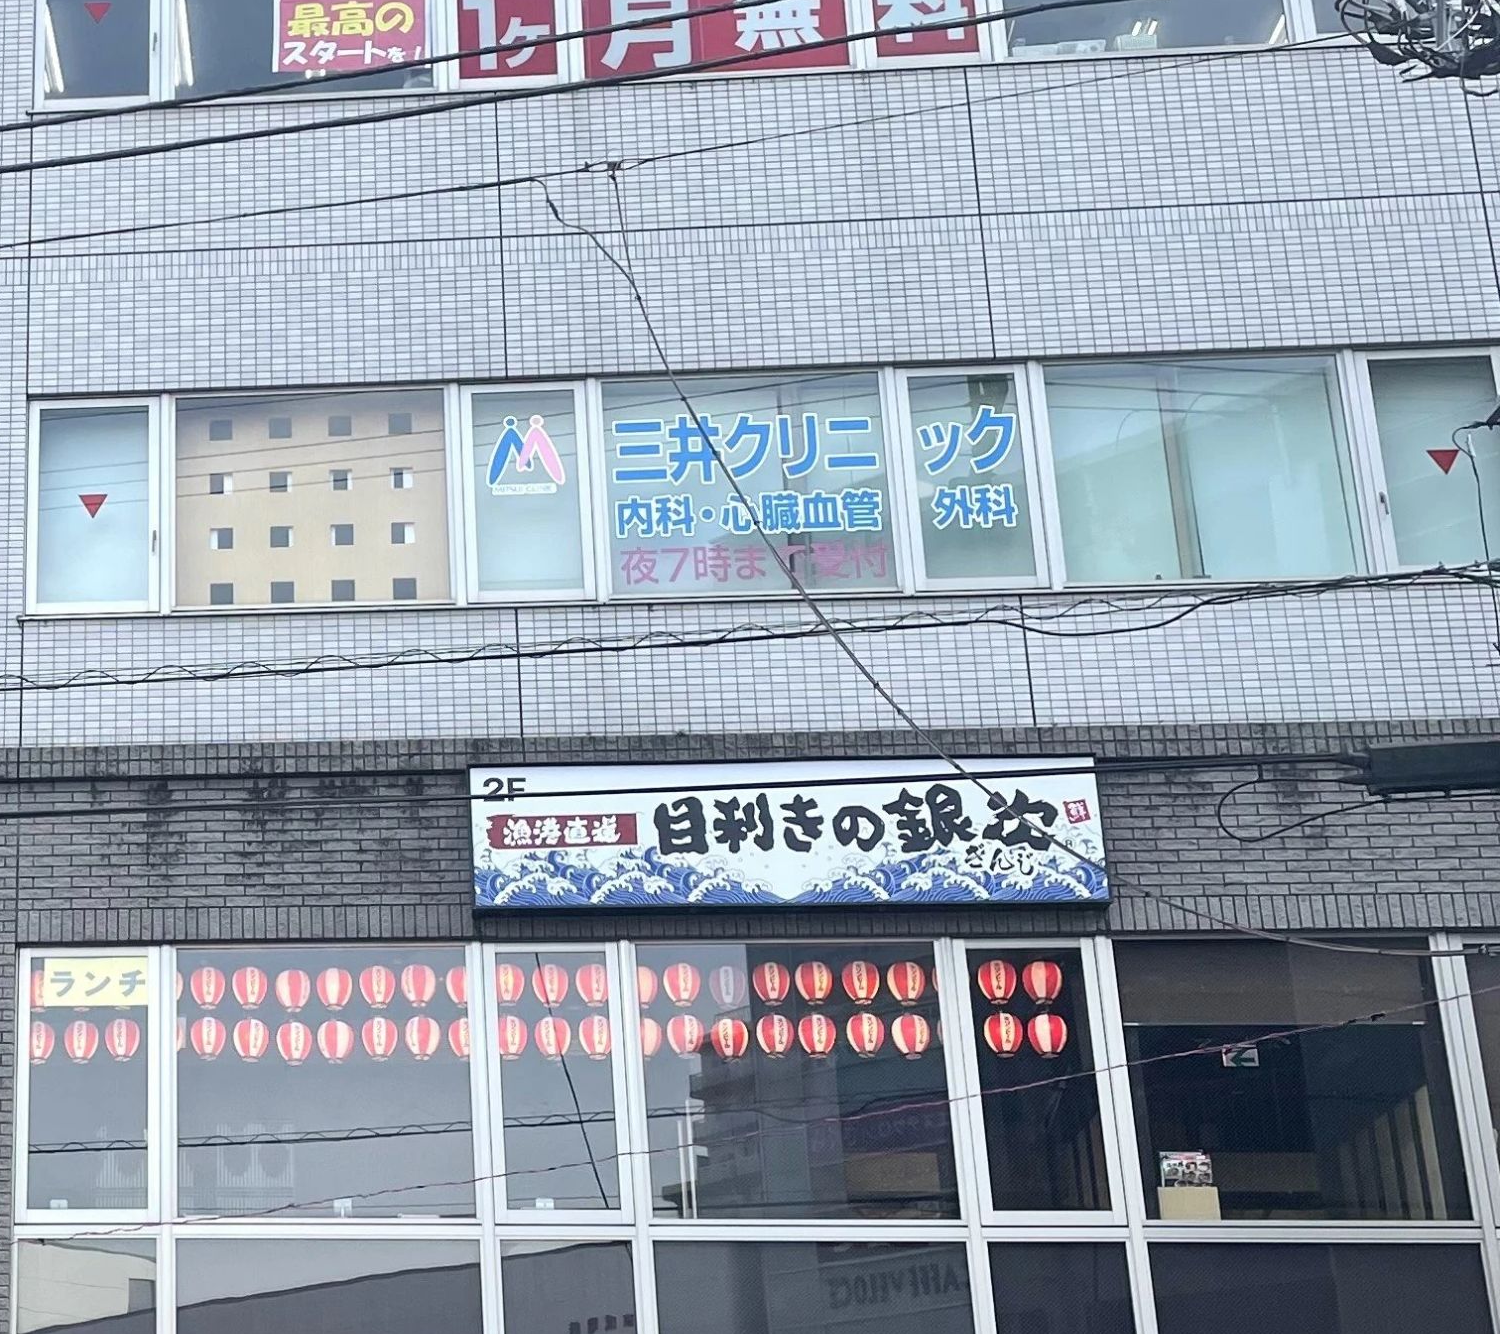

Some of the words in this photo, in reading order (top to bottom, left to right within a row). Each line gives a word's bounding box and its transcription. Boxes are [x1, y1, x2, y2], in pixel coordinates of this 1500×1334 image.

[287, 1, 414, 37] 最高の
[611, 405, 1017, 485] 三井クリニック
[483, 778, 526, 802] 2F
[653, 784, 1058, 855] 目利きの銀次
[50, 970, 146, 997] ランチ
